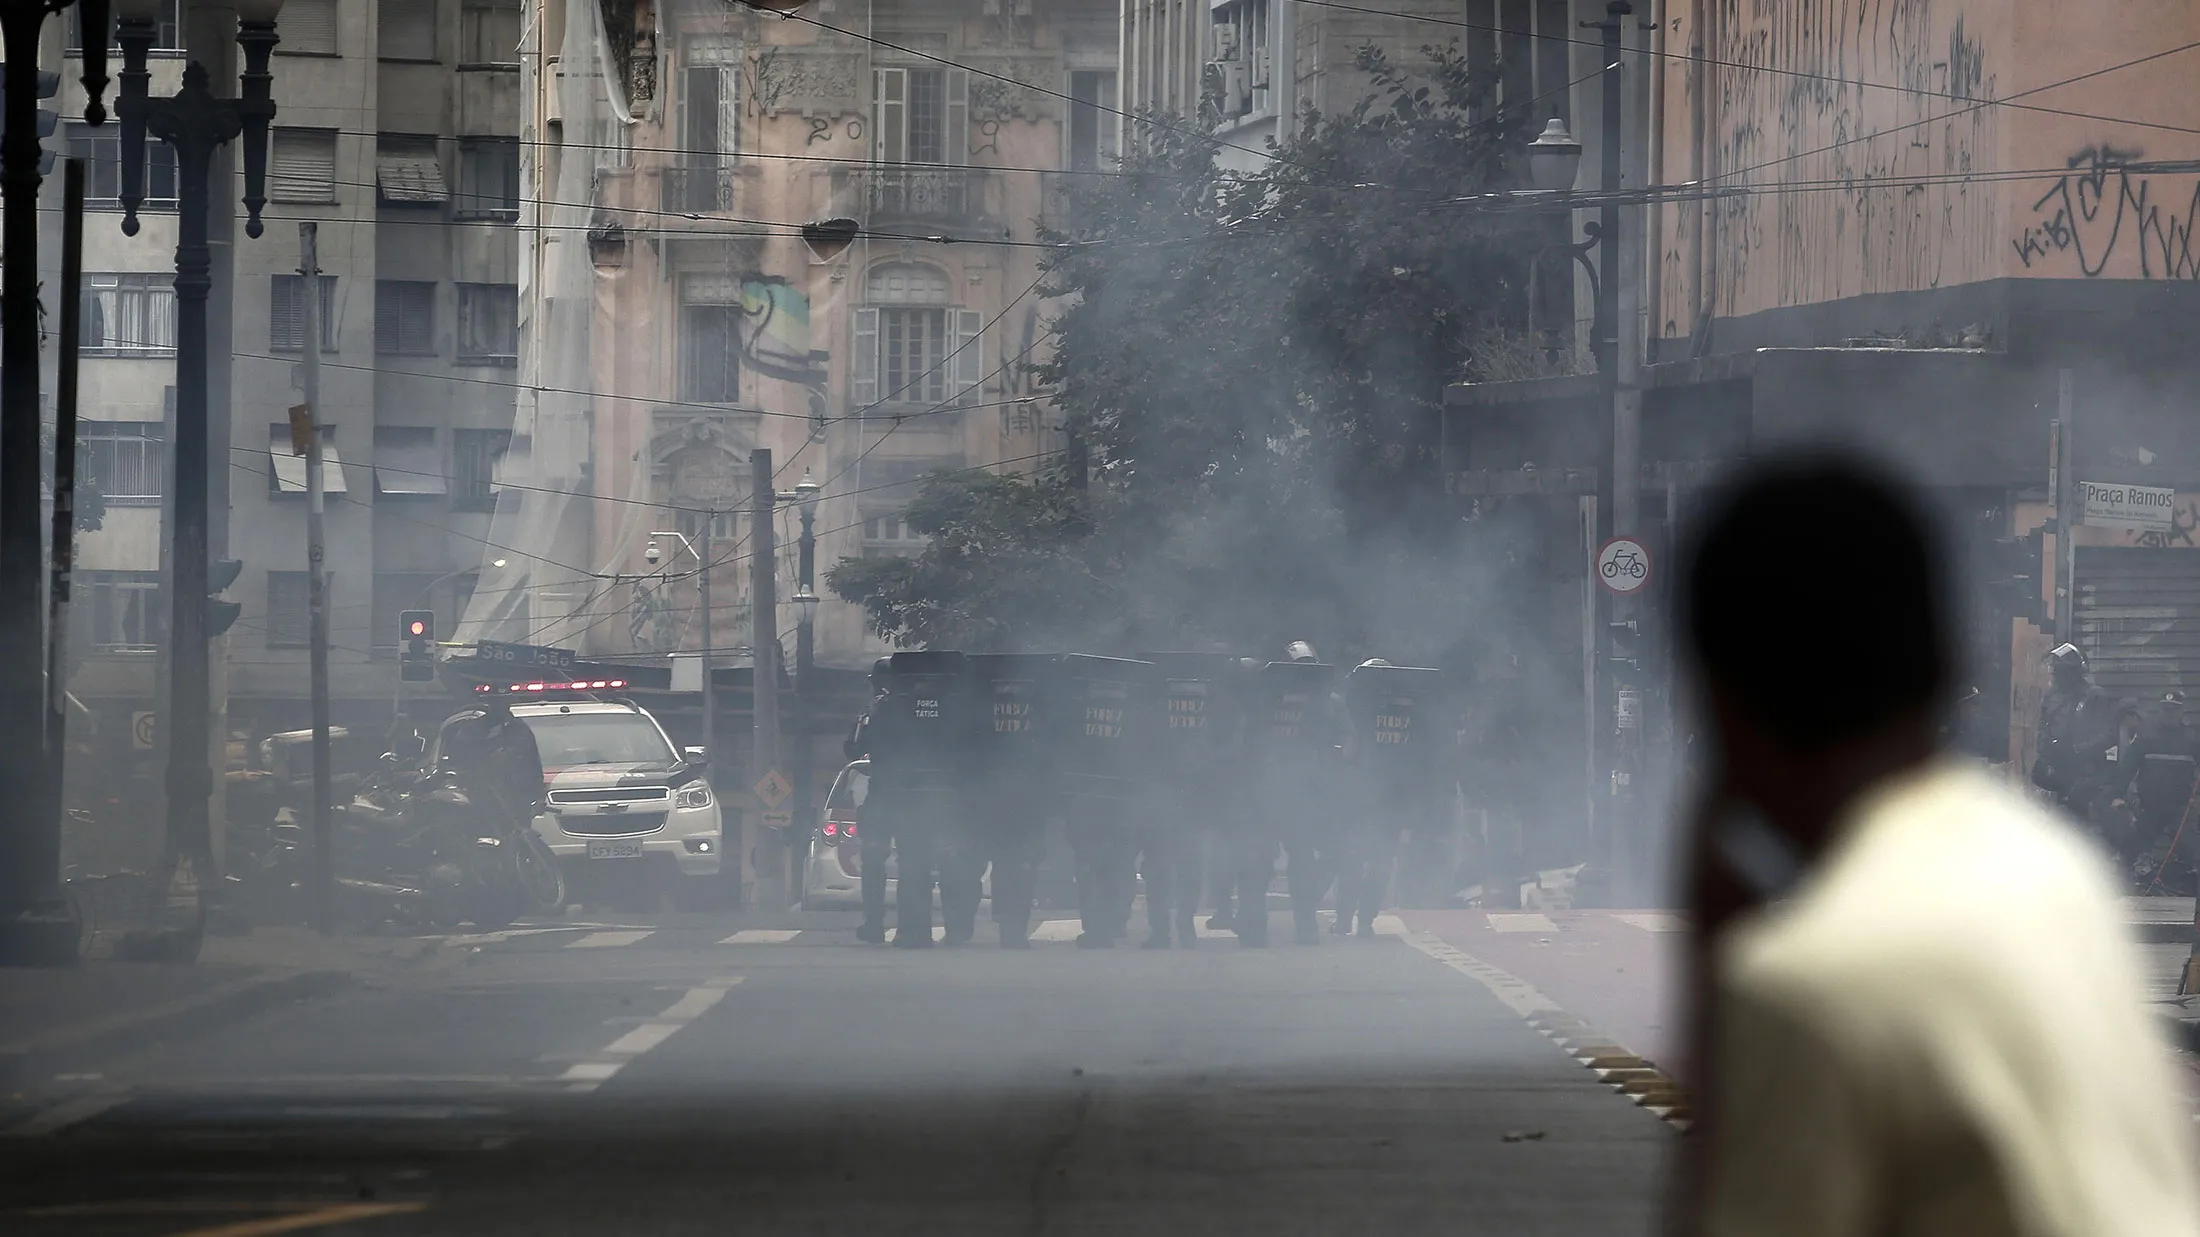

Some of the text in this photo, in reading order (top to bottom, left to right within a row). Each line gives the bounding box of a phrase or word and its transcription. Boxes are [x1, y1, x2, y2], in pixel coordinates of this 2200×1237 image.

[2087, 485, 2173, 508] Praça Ramos
[482, 644, 570, 667] São João
